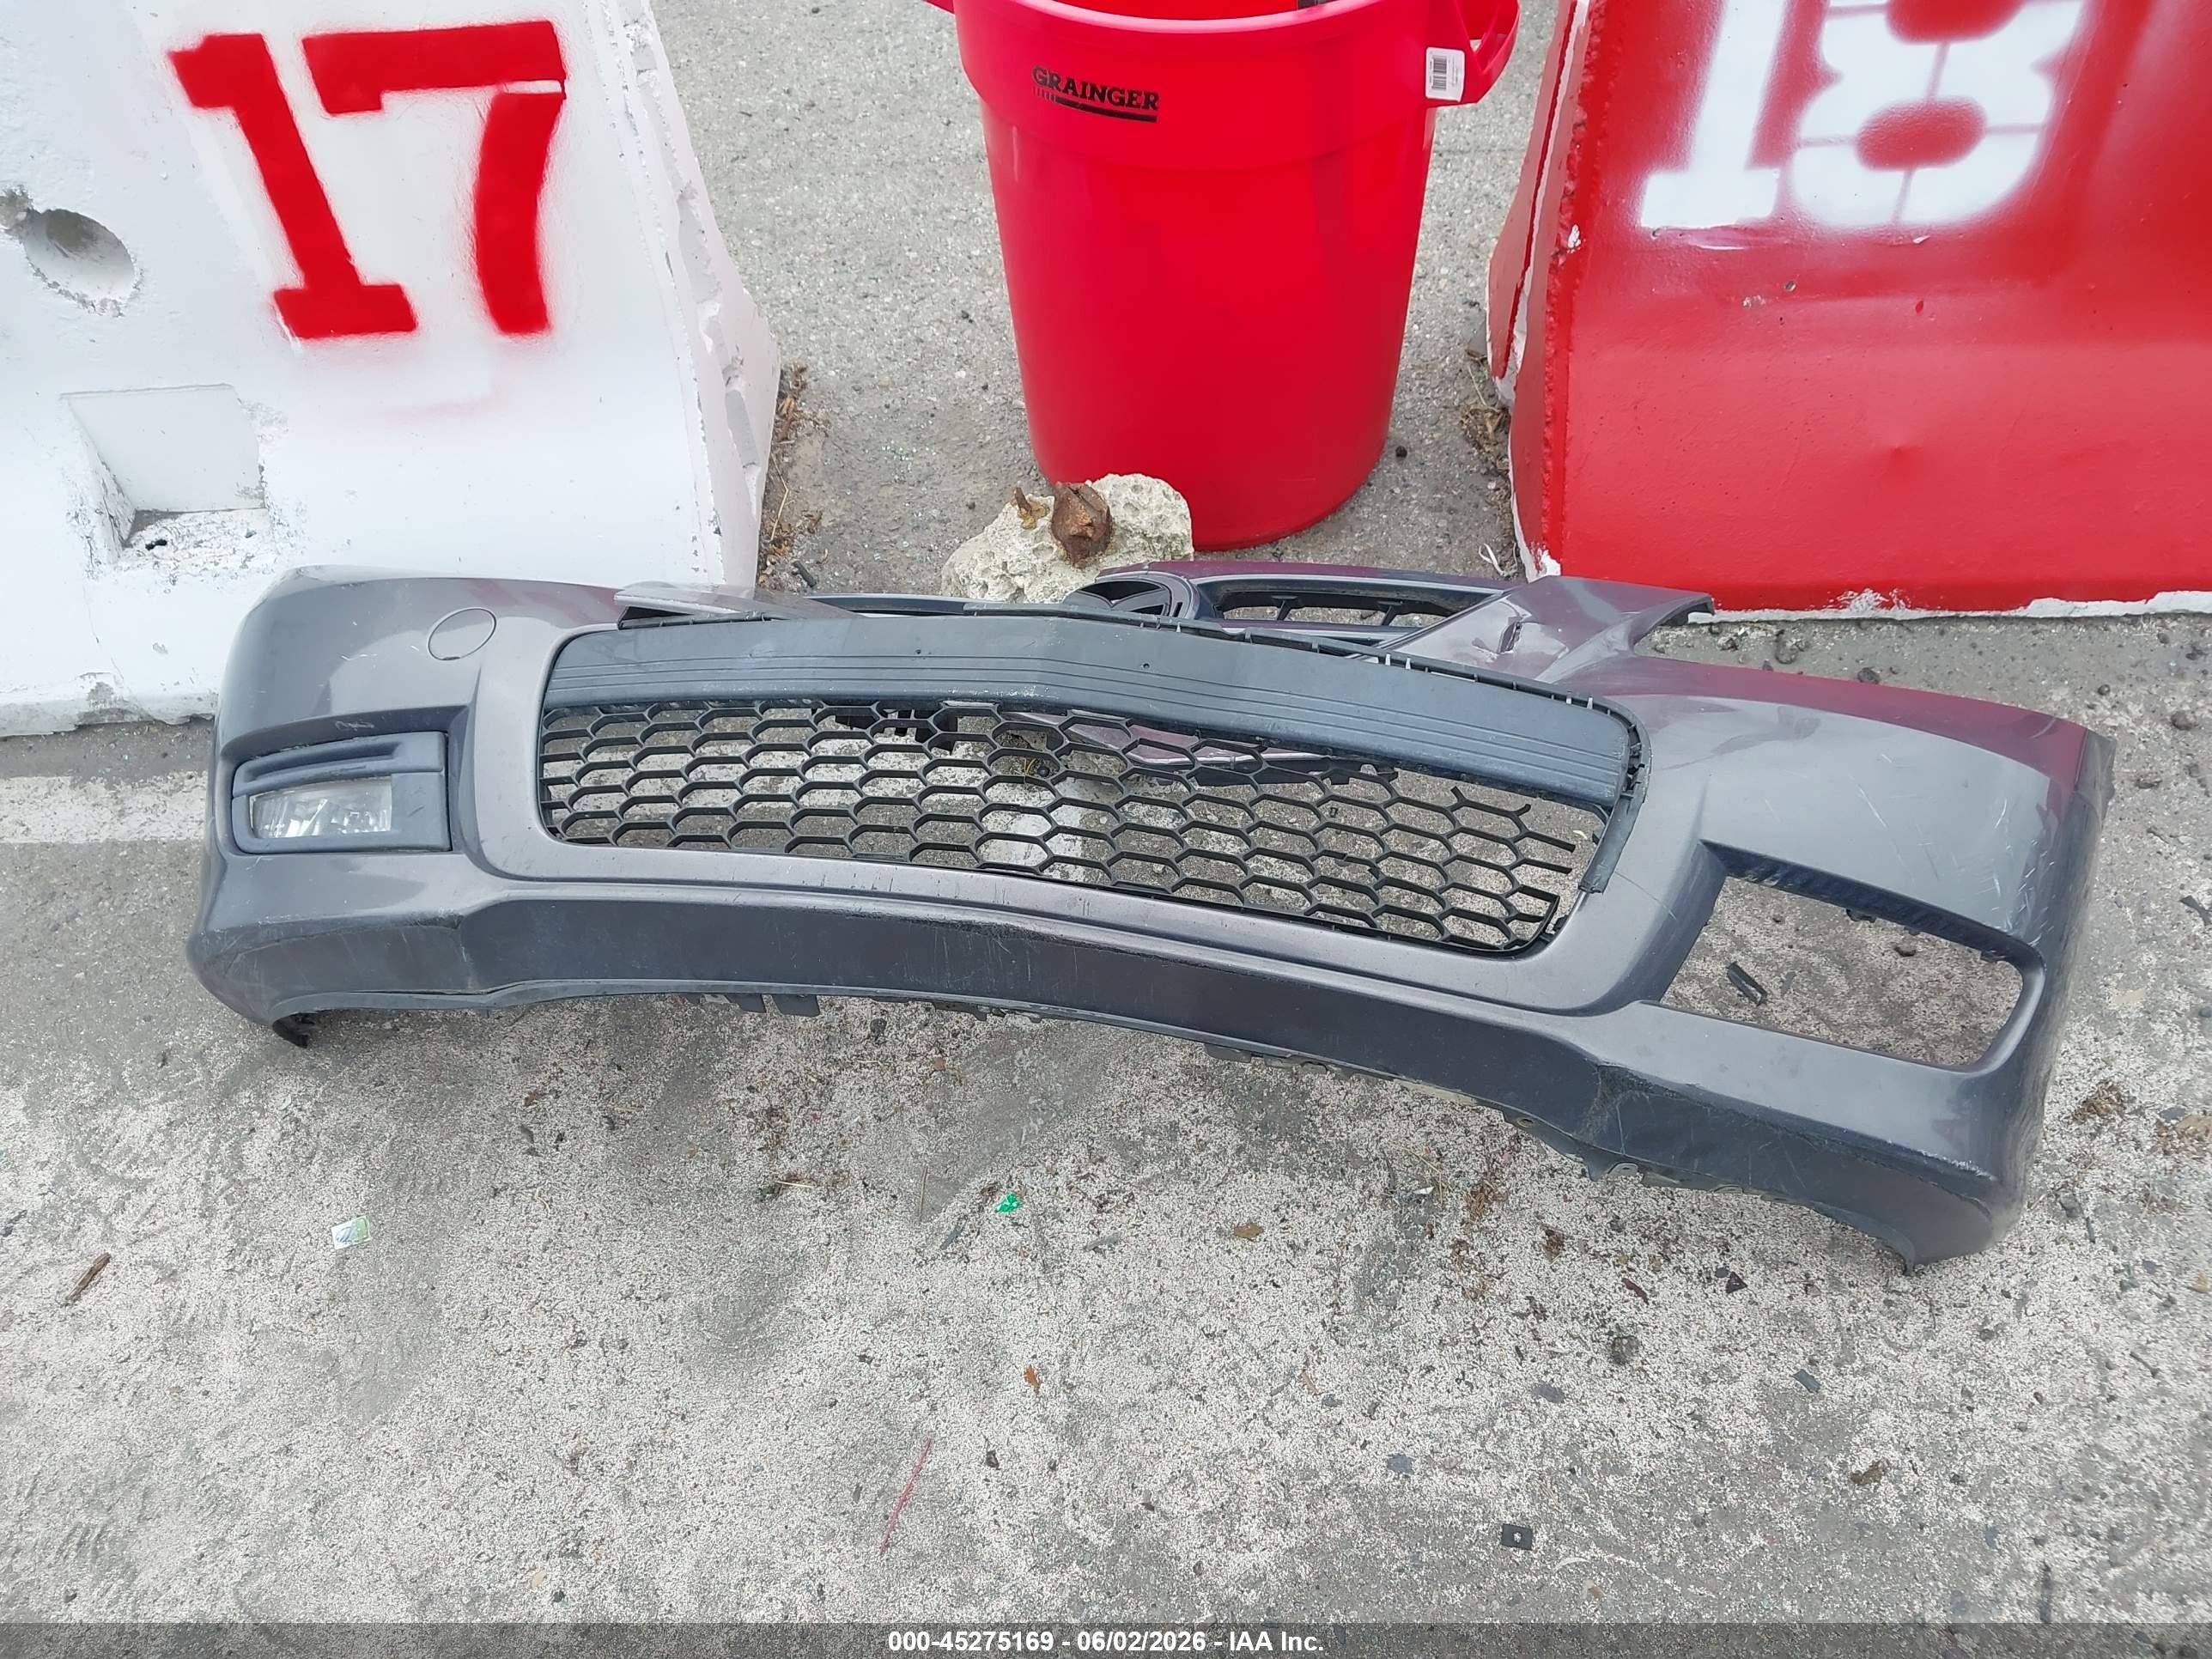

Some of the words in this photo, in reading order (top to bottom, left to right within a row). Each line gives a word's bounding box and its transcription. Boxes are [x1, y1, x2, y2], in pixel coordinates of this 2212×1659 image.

[168, 20, 568, 340] 17
[1032, 64, 1159, 111] GRAINGER
[1640, 0, 2087, 229] 18
